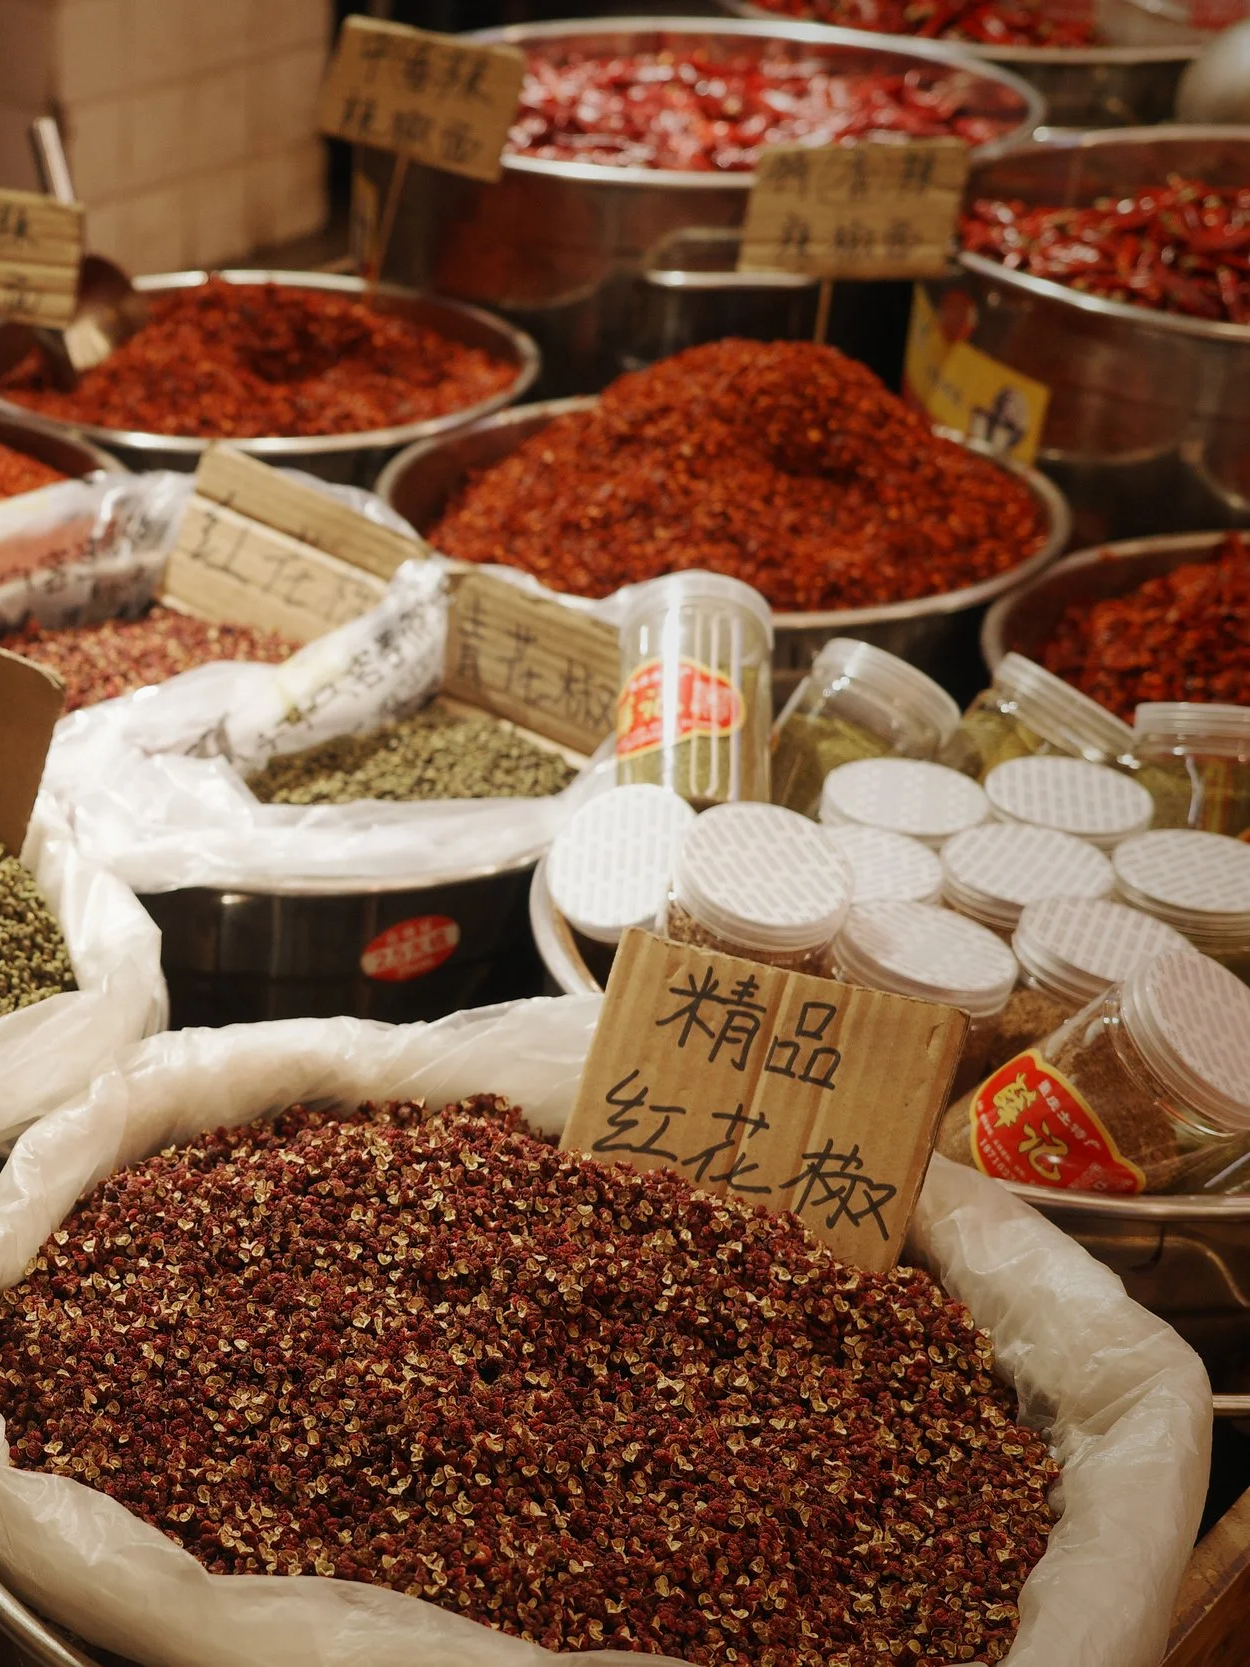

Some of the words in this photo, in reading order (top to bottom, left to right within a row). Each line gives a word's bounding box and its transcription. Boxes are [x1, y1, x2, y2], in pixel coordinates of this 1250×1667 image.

[655, 966, 842, 1091] 精品
[591, 1069, 898, 1241] 红花椒
